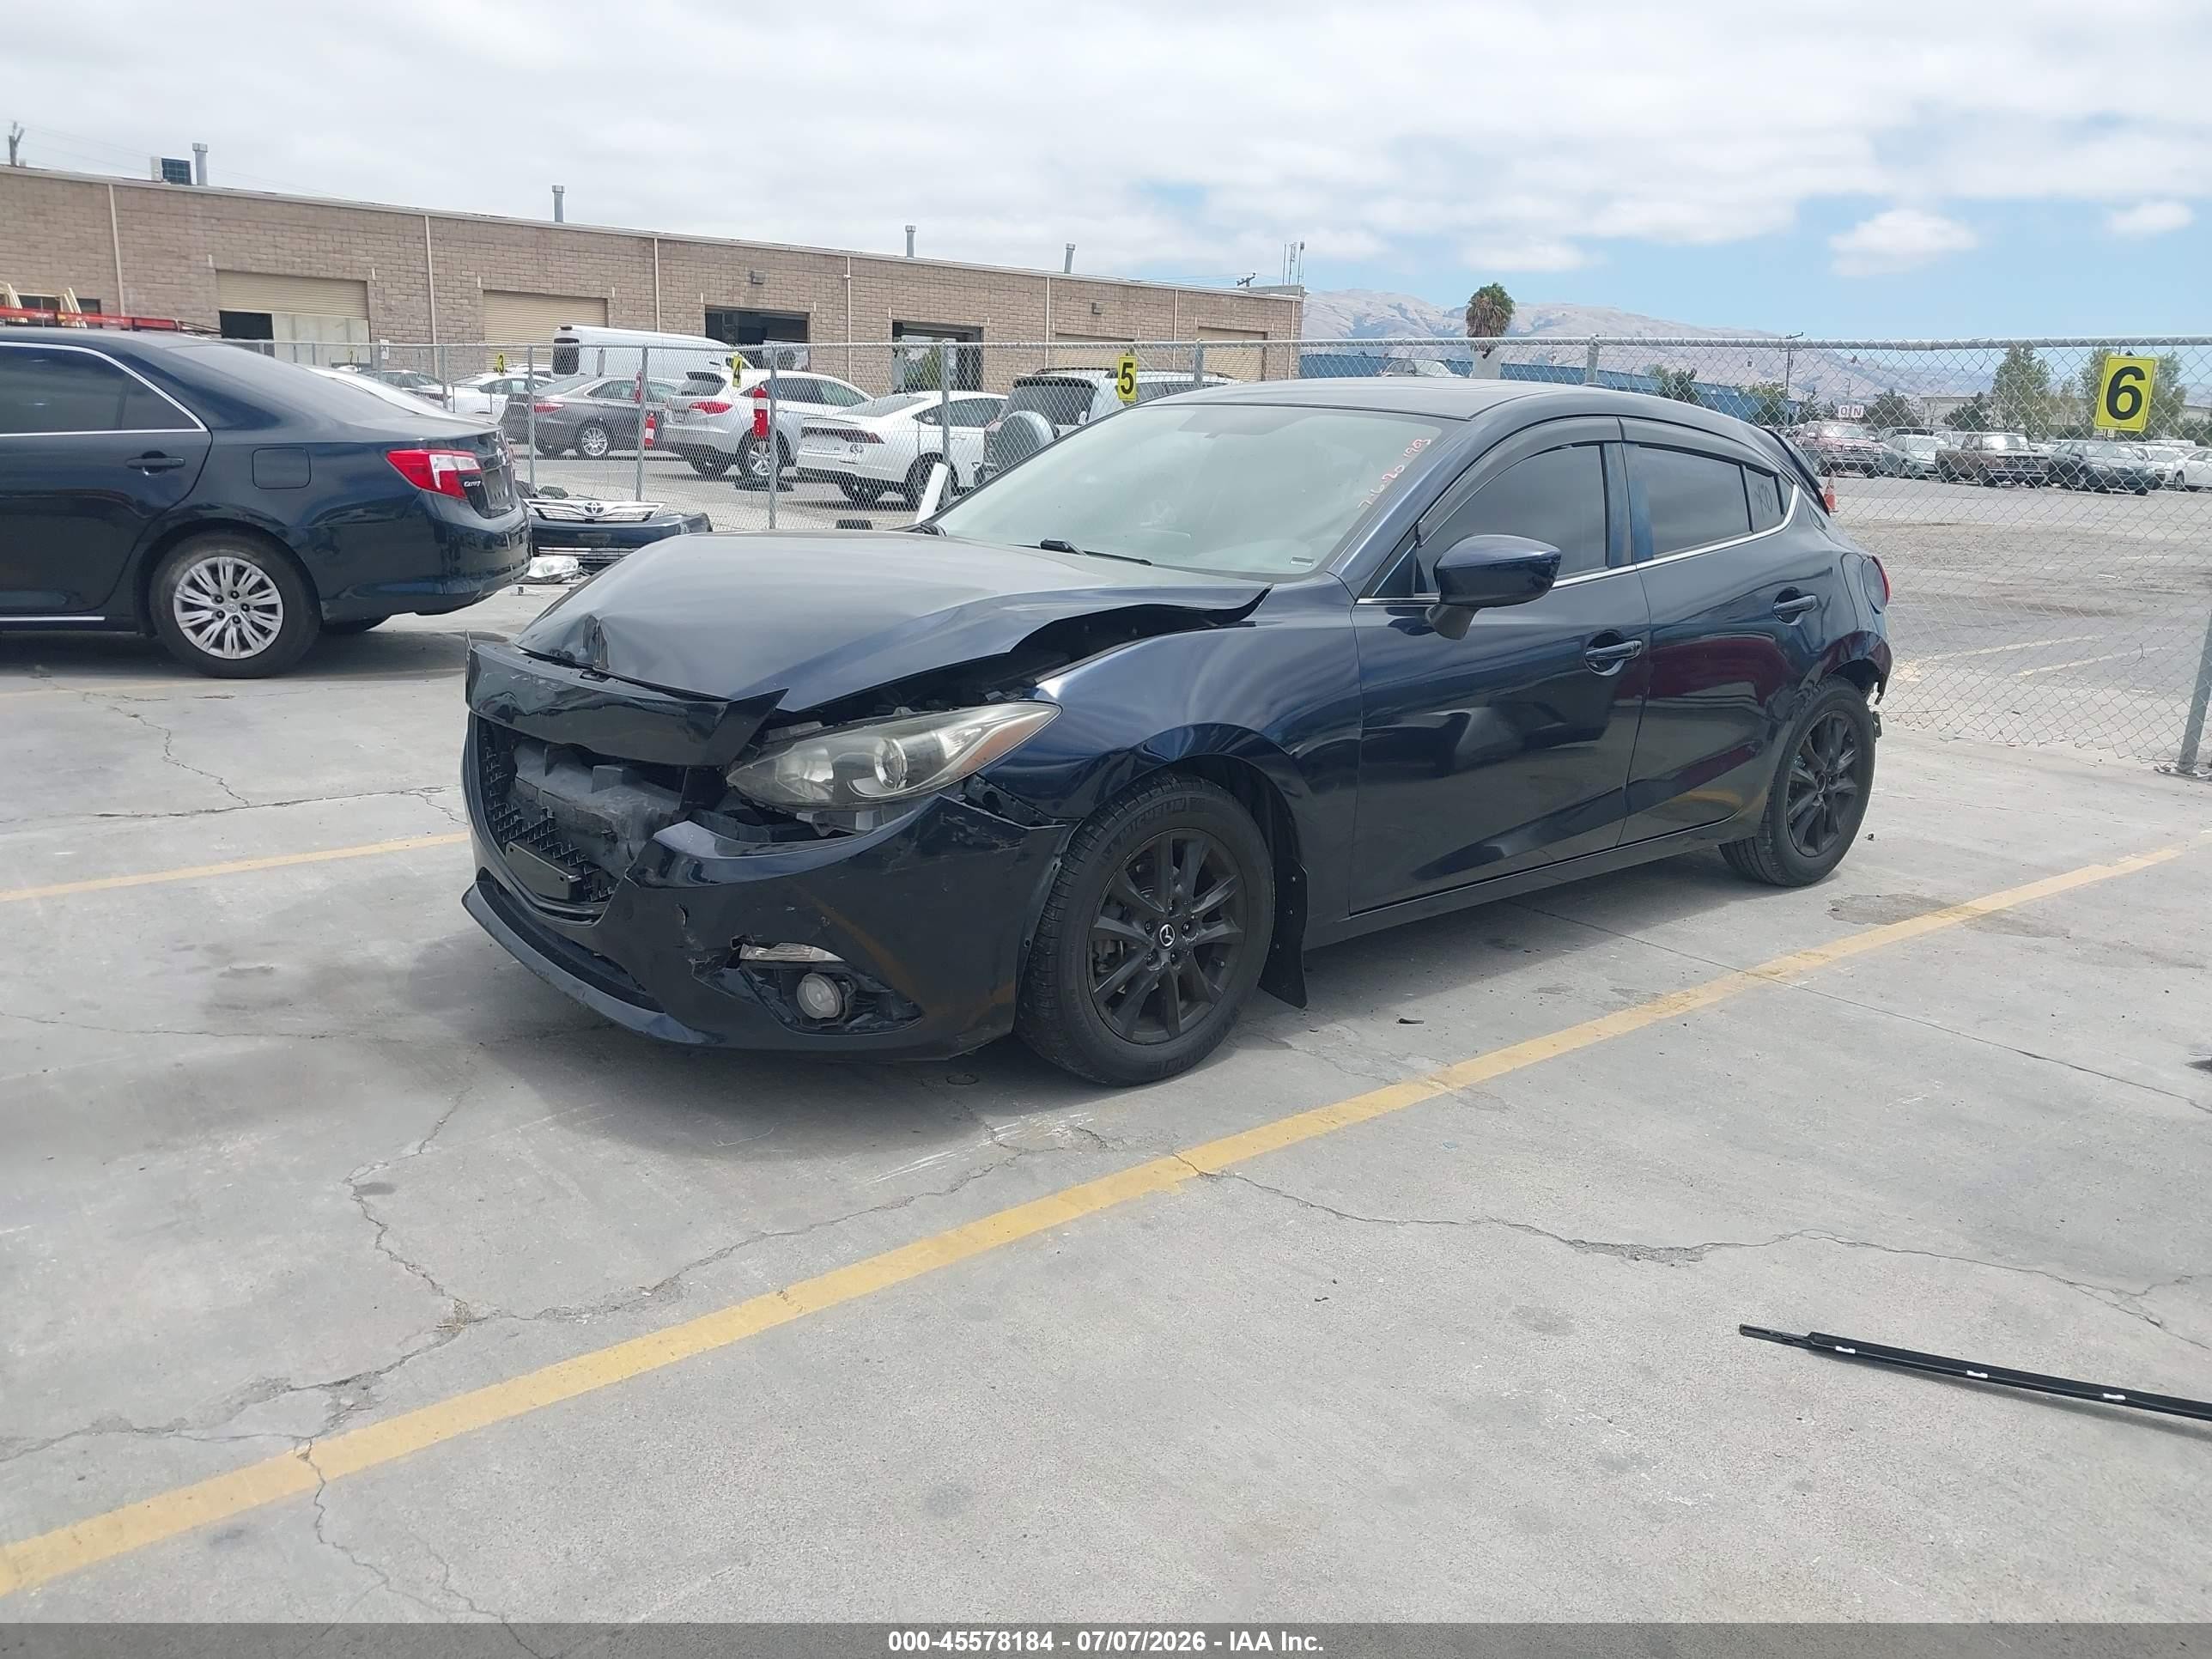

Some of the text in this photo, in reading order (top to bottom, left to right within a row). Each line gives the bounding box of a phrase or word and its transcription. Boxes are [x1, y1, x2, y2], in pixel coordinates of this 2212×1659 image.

[498, 355, 505, 374] 3
[733, 360, 741, 384] 4
[1120, 362, 1134, 395] 5
[2106, 366, 2146, 421] 6
[1853, 407, 1862, 416] N
